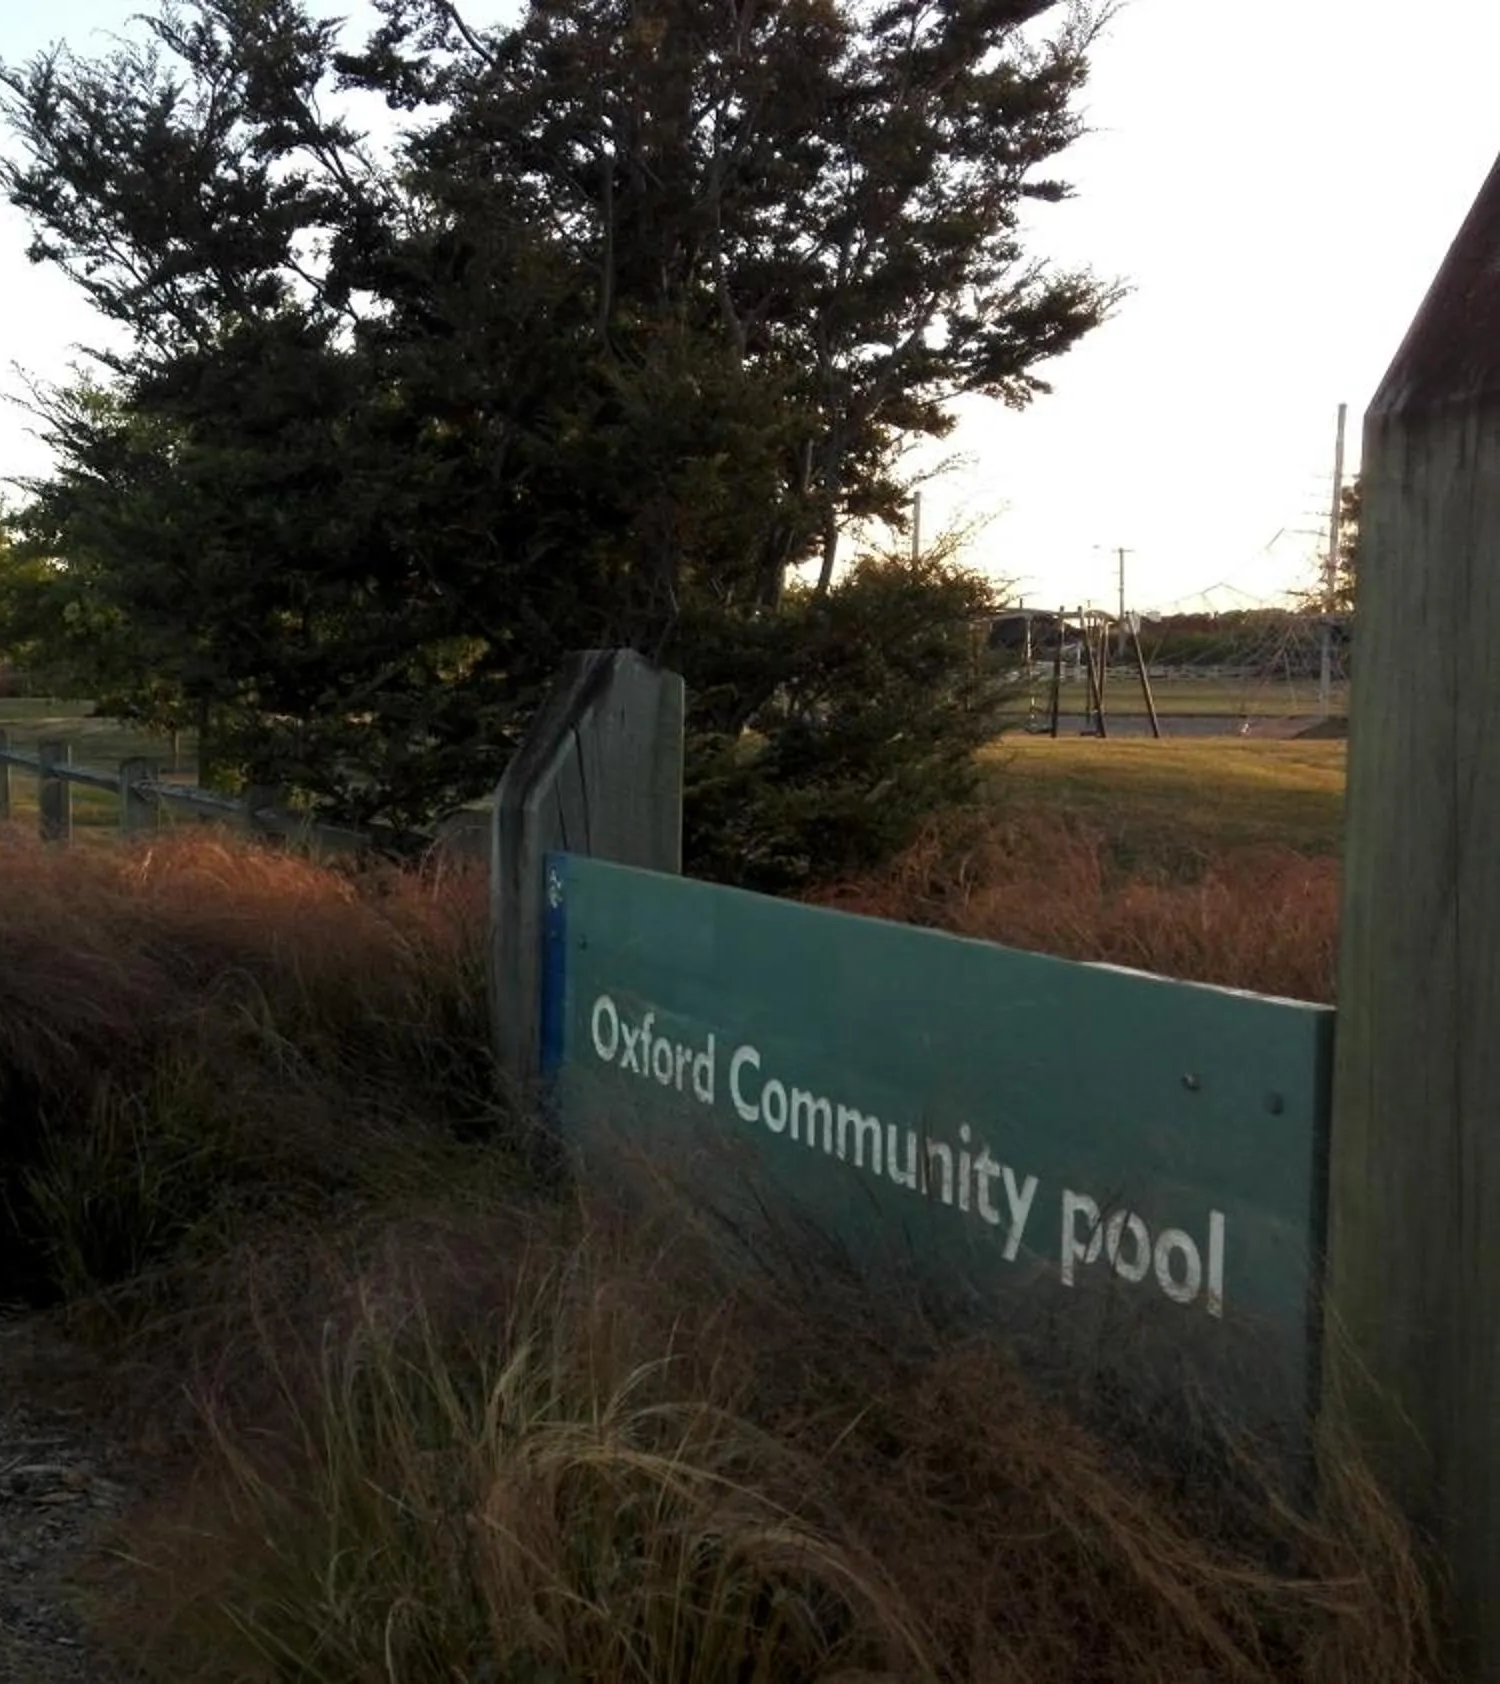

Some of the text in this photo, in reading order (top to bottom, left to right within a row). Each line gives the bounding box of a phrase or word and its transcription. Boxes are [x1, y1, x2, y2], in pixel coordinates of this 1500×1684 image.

[589, 994, 1225, 1318] Oxford Community pool
